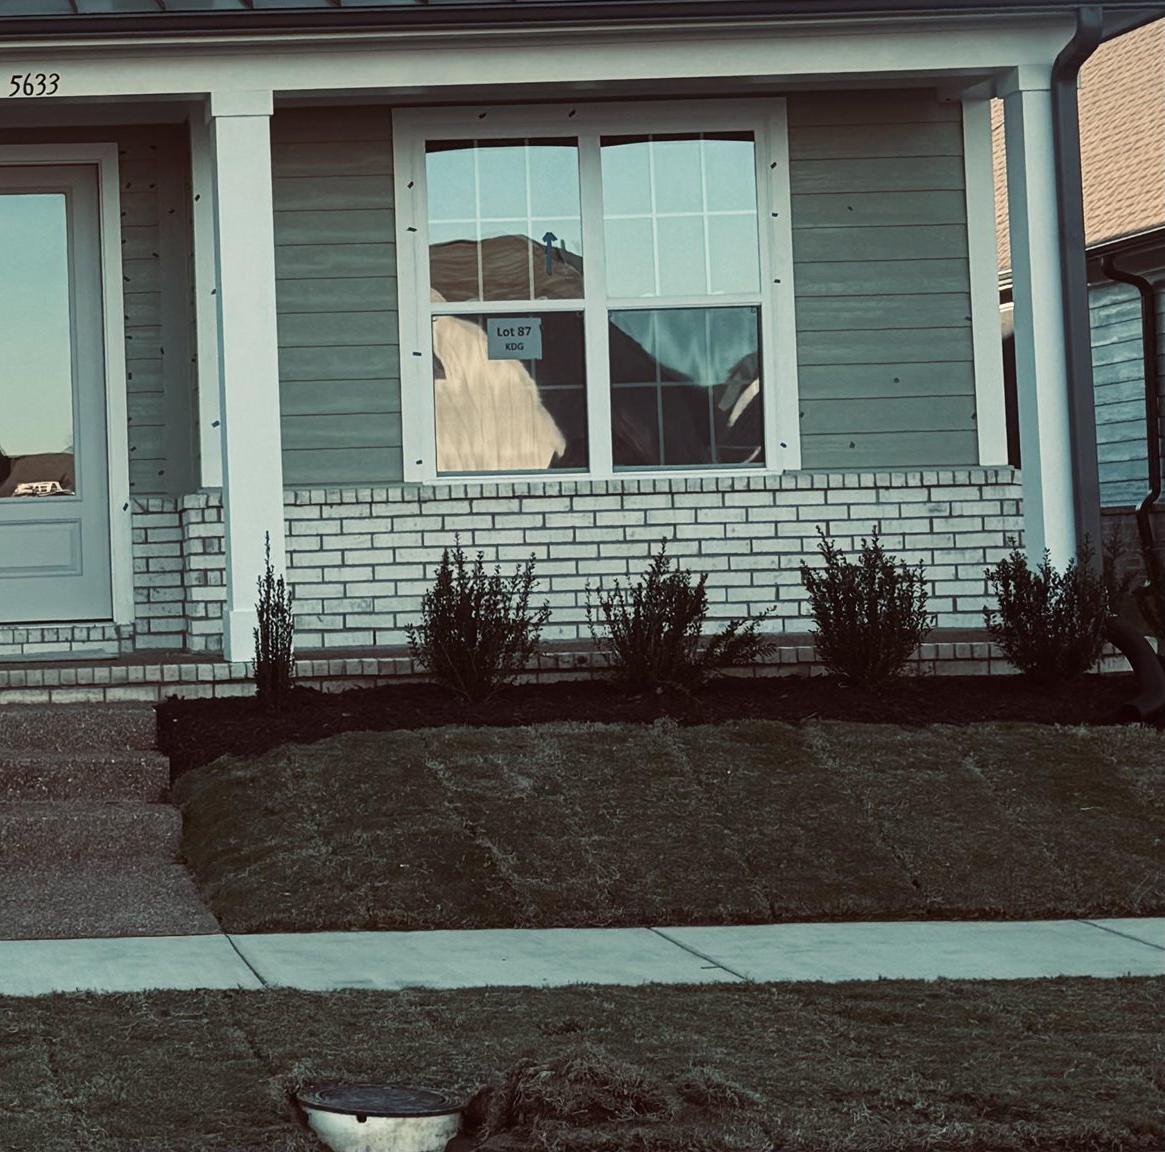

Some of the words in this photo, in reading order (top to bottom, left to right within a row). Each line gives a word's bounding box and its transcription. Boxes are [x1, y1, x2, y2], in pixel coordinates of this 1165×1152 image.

[9, 73, 60, 97] 5633
[497, 327, 515, 337] Lot
[517, 326, 532, 337] 87
[505, 342, 525, 351] KDG
